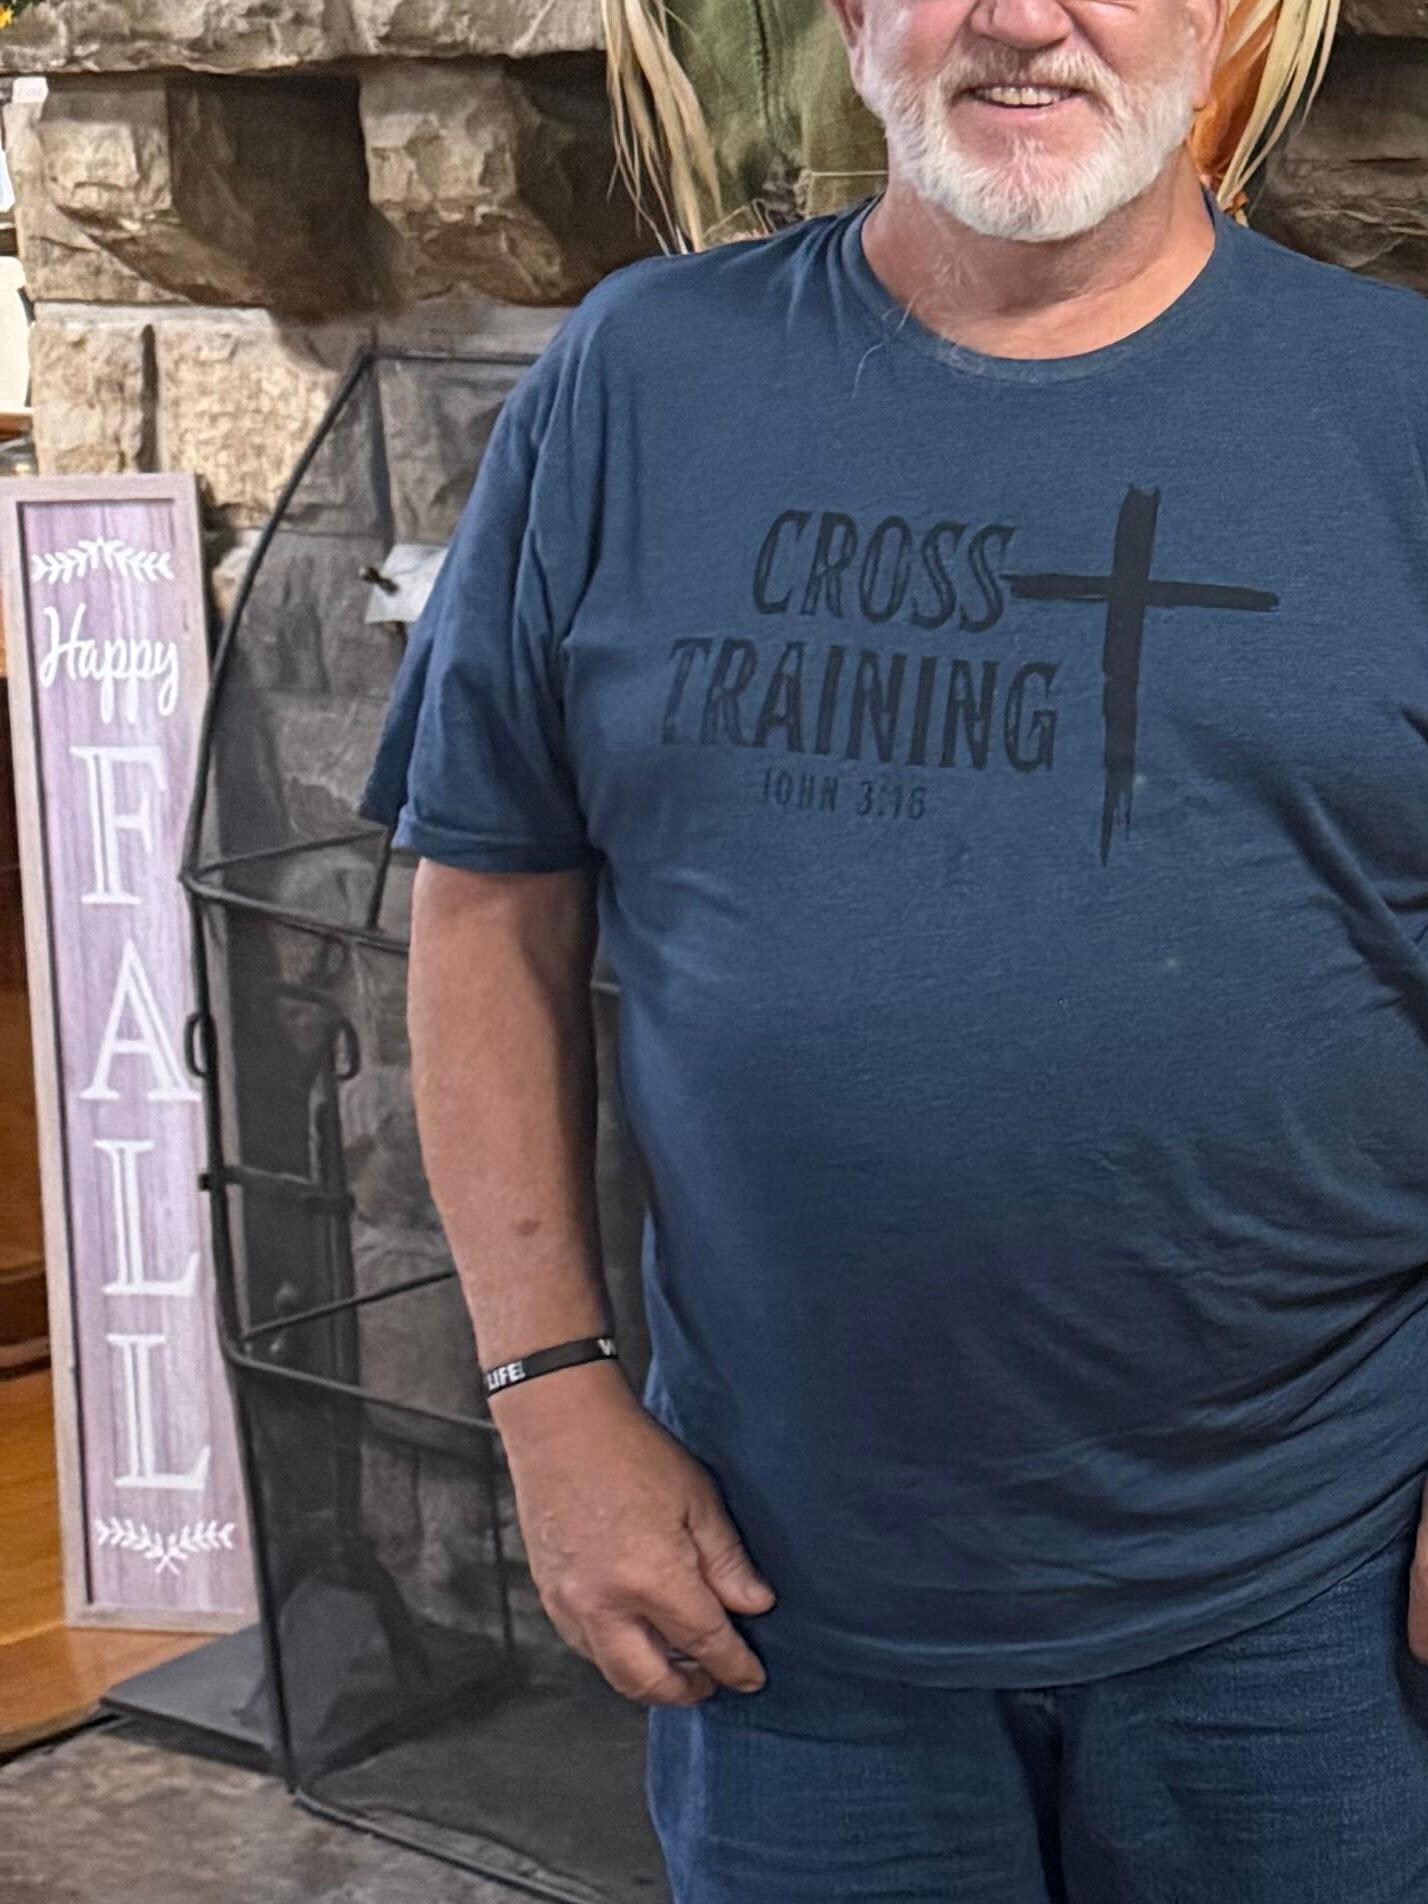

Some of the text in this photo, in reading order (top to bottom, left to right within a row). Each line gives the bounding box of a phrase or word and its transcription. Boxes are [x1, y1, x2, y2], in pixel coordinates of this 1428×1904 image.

[753, 509, 1015, 633] CROSS
[39, 602, 180, 724] Happy
[661, 637, 1062, 773] TRAINING
[857, 780, 926, 821] 3:16
[70, 746, 211, 1491] FALL
